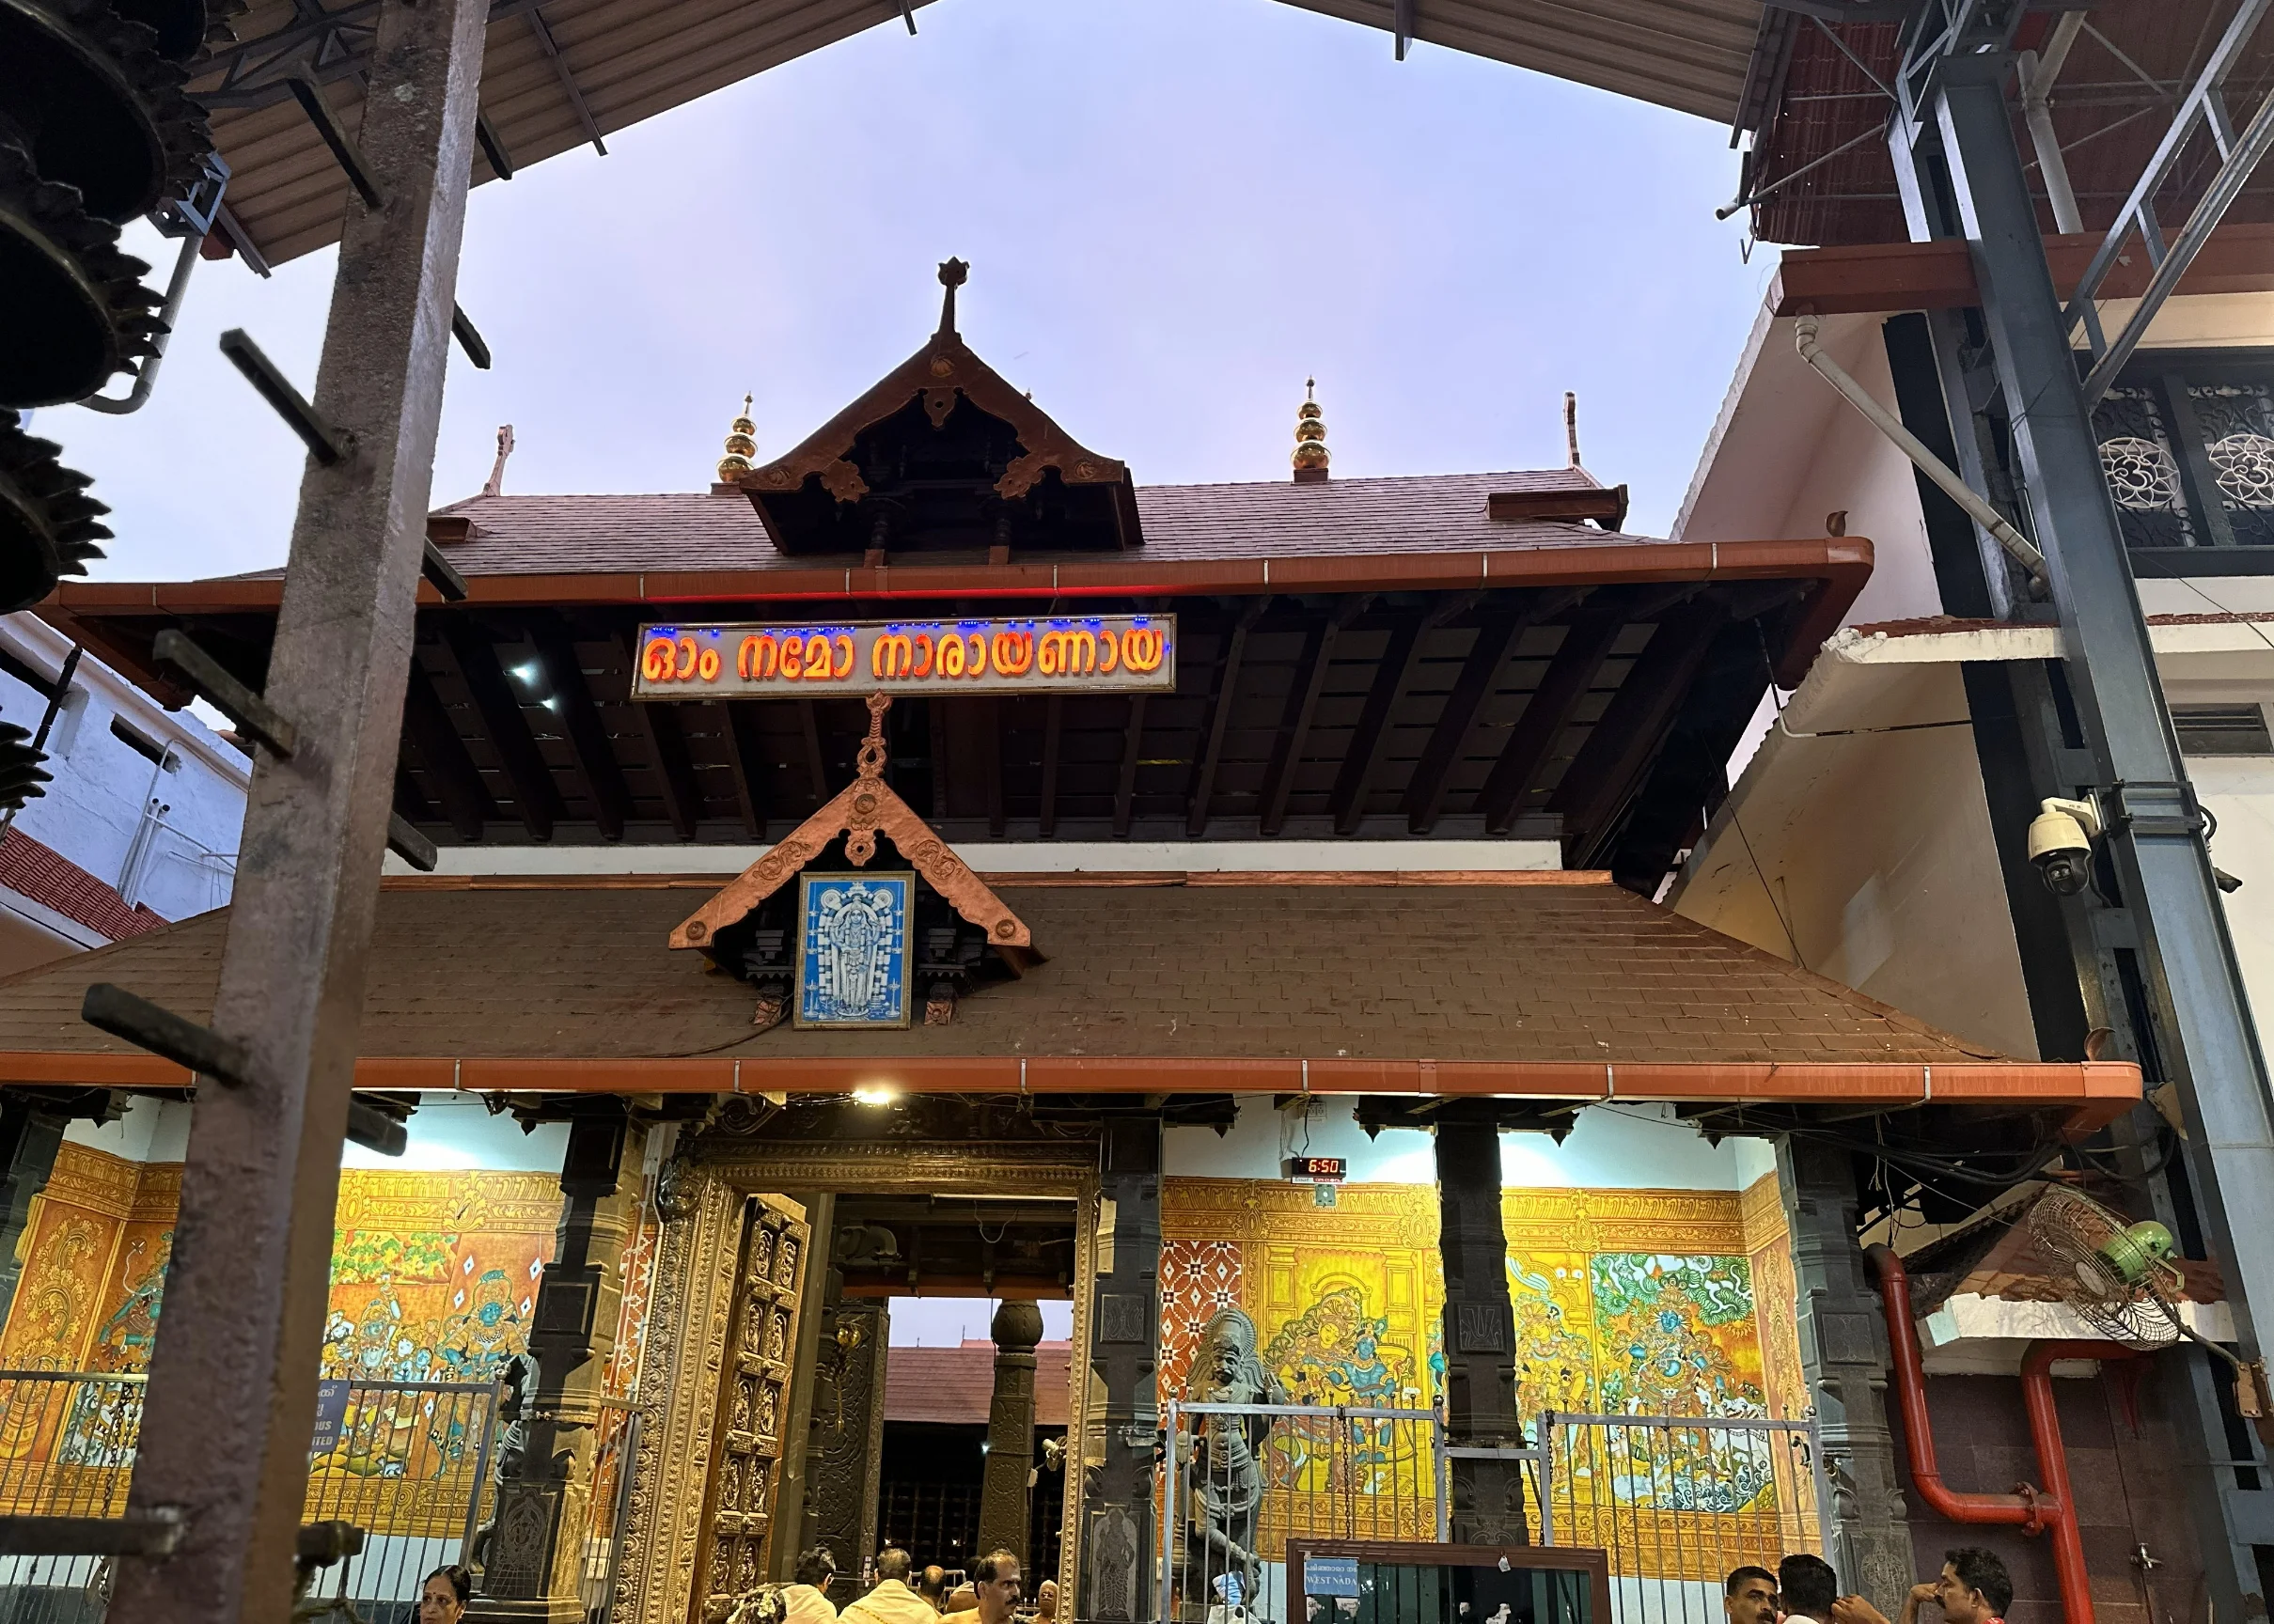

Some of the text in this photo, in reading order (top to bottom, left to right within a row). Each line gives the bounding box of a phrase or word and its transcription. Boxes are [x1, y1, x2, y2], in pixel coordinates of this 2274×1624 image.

[642, 628, 1164, 682] ഓം നമോ നാരായണായ
[1309, 1160, 1339, 1173] 6:50
[312, 1436, 333, 1446] ITED
[1307, 1576, 1357, 1585] WEST NADA
